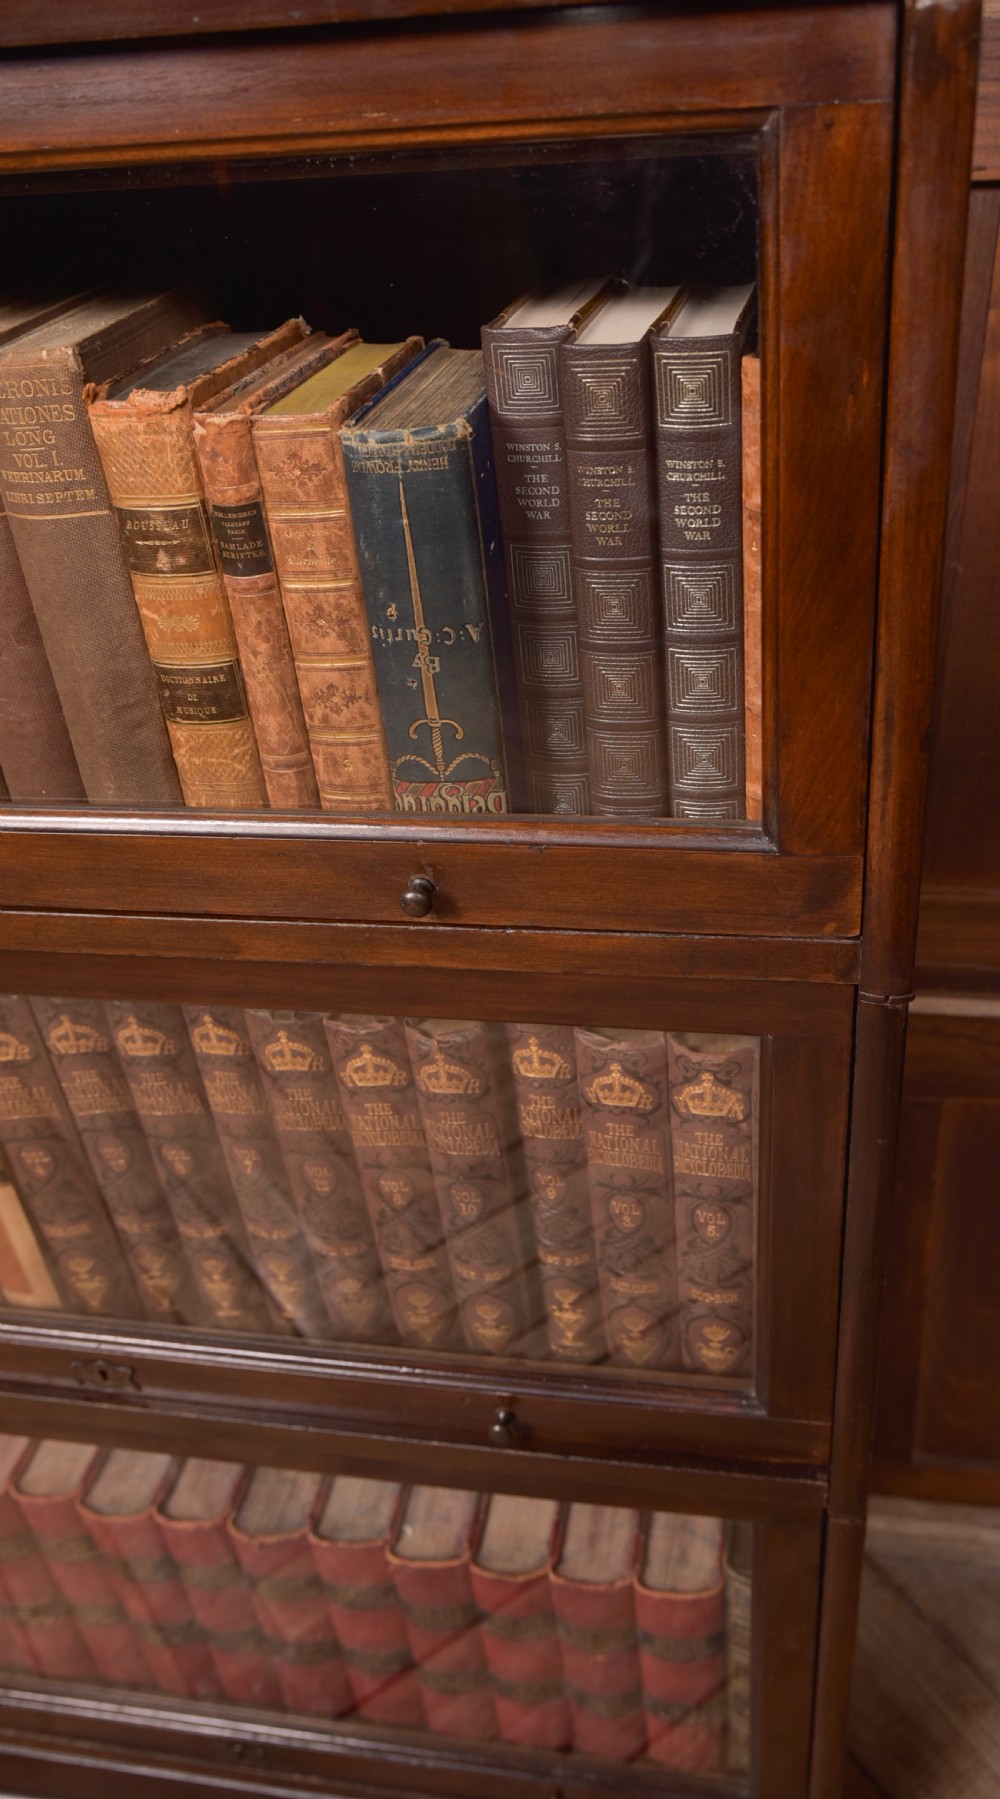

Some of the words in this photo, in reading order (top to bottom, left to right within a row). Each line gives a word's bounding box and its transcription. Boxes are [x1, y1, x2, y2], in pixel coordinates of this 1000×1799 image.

[3, 429, 56, 446] LONG
[506, 443, 550, 452] WINSTON
[12, 453, 47, 468] VOL.
[51, 450, 64, 466] I.
[407, 456, 449, 471] HENRY
[507, 454, 562, 463] CHURCHILL
[352, 460, 402, 473] FROWDE
[665, 460, 714, 469] WINSTON
[1, 469, 86, 483] VERRINARUM
[577, 466, 623, 475] WINSTON
[524, 474, 549, 482] THE
[578, 478, 636, 487] CHURCHILL
[666, 472, 726, 482] CHURCHILL
[515, 486, 560, 495] SECOND
[5, 491, 35, 504] LIBRI
[684, 492, 710, 502] THE
[517, 498, 560, 508] WORLD
[594, 498, 620, 508] THE
[525, 511, 551, 520] WAR
[586, 510, 632, 520] SECOND
[674, 504, 722, 516] SECOND
[126, 518, 190, 531] ROUSSEAU
[586, 523, 633, 532] WORLD
[675, 518, 722, 528] WORLD
[595, 536, 623, 546] WAR
[684, 531, 712, 540] WAR
[220, 540, 263, 551] SAMLADE
[222, 550, 266, 560] SKRIFTER
[160, 674, 227, 685] DICTIONNAIRE
[187, 693, 199, 702] DE
[175, 706, 218, 719] MUSIQUE
[285, 1088, 313, 1101] THE
[528, 1094, 556, 1109] THE
[364, 1103, 393, 1116] THE
[517, 1103, 583, 1125] NATIONAL
[350, 1114, 421, 1131] NATIONAL
[439, 1112, 466, 1125] THE
[424, 1118, 494, 1140] NATIONAL
[606, 1122, 634, 1137] THE
[588, 1129, 661, 1155] NATIONAL
[694, 1132, 724, 1147] THE
[675, 1138, 750, 1163] NATIONAL
